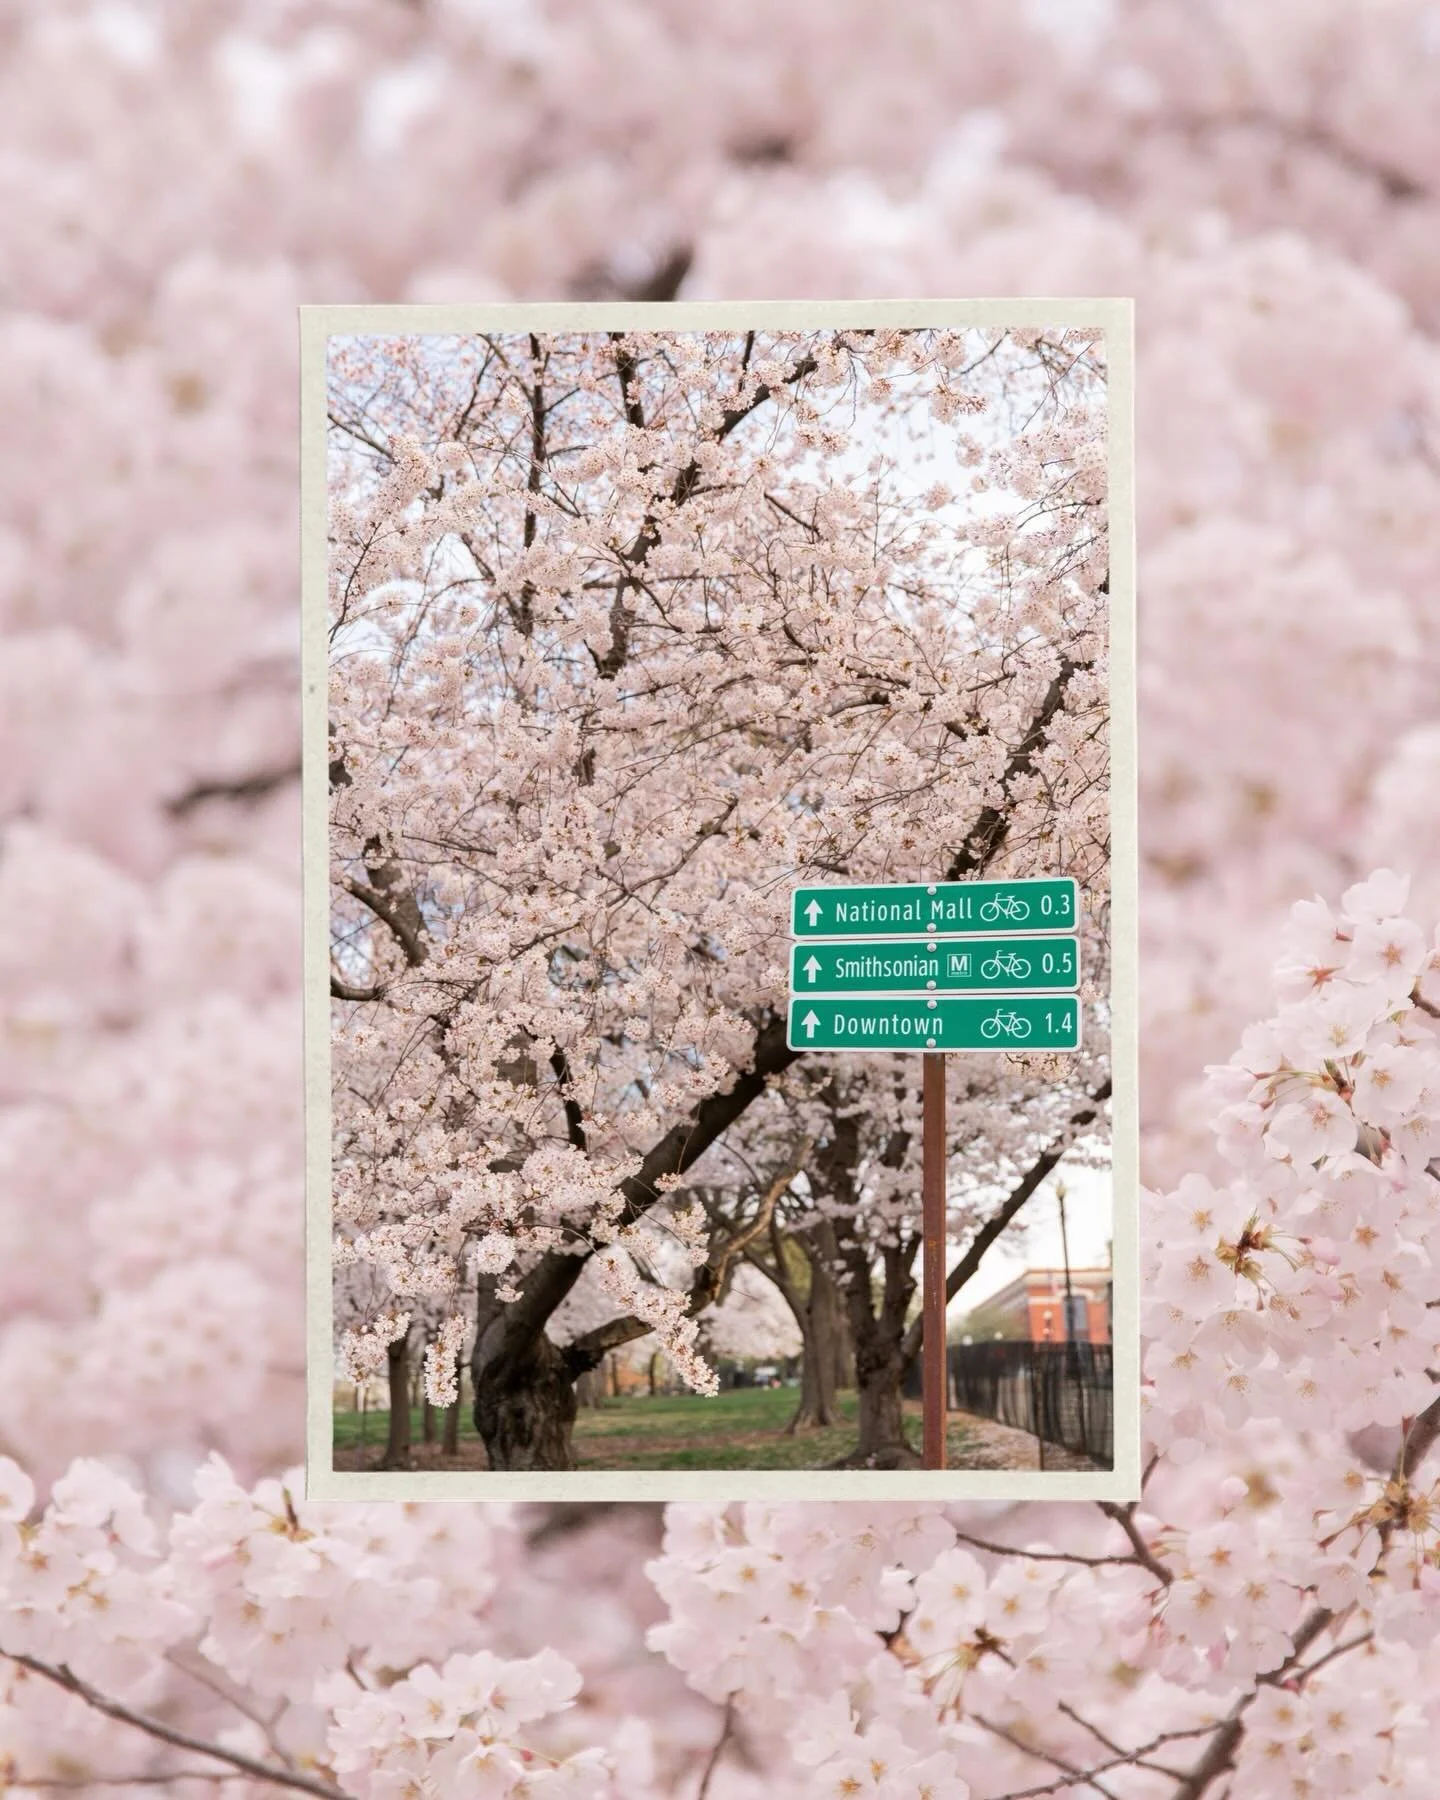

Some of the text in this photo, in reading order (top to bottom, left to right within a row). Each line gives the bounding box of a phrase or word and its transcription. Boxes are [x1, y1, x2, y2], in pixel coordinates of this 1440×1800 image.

[836, 894, 1070, 922] National Mall 0.3
[835, 952, 1072, 979] Smithsonian M 0.5
[834, 1012, 1072, 1036] Downtown 1.4
